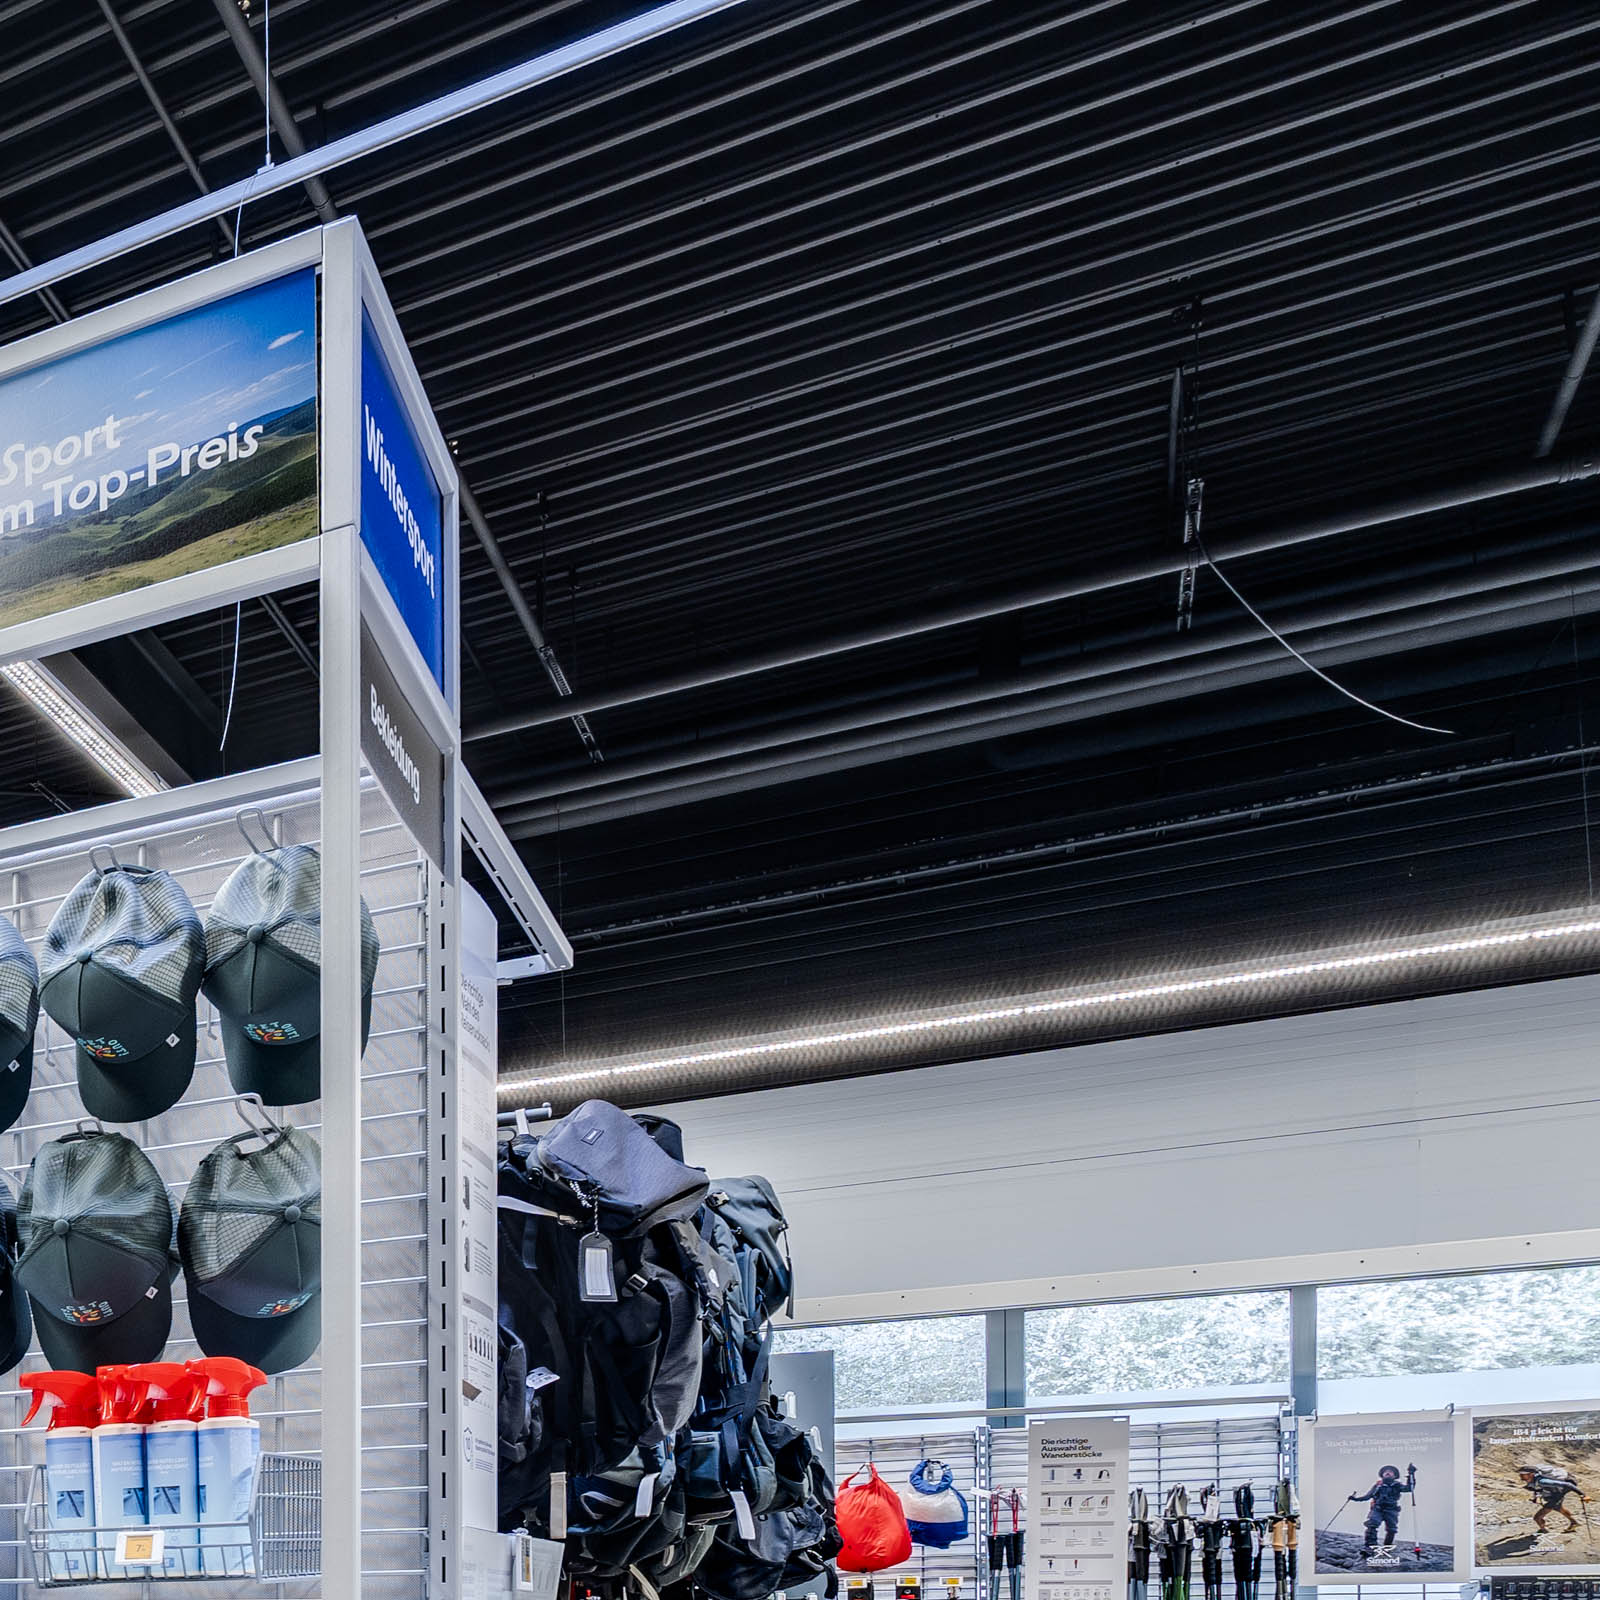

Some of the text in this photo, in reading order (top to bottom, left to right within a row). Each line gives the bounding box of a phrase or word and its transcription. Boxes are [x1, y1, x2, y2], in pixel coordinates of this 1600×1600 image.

[42, 422, 264, 517] Top-Preis
[365, 404, 436, 600] Wintersport
[369, 682, 422, 805] Bekleidung
[1564, 1426, 1578, 1434] für
[1056, 1437, 1088, 1446] richtige
[1041, 1444, 1077, 1452] Auswahl
[1041, 1450, 1102, 1458] Wanderstöcke
[1367, 1556, 1400, 1565] Simond
